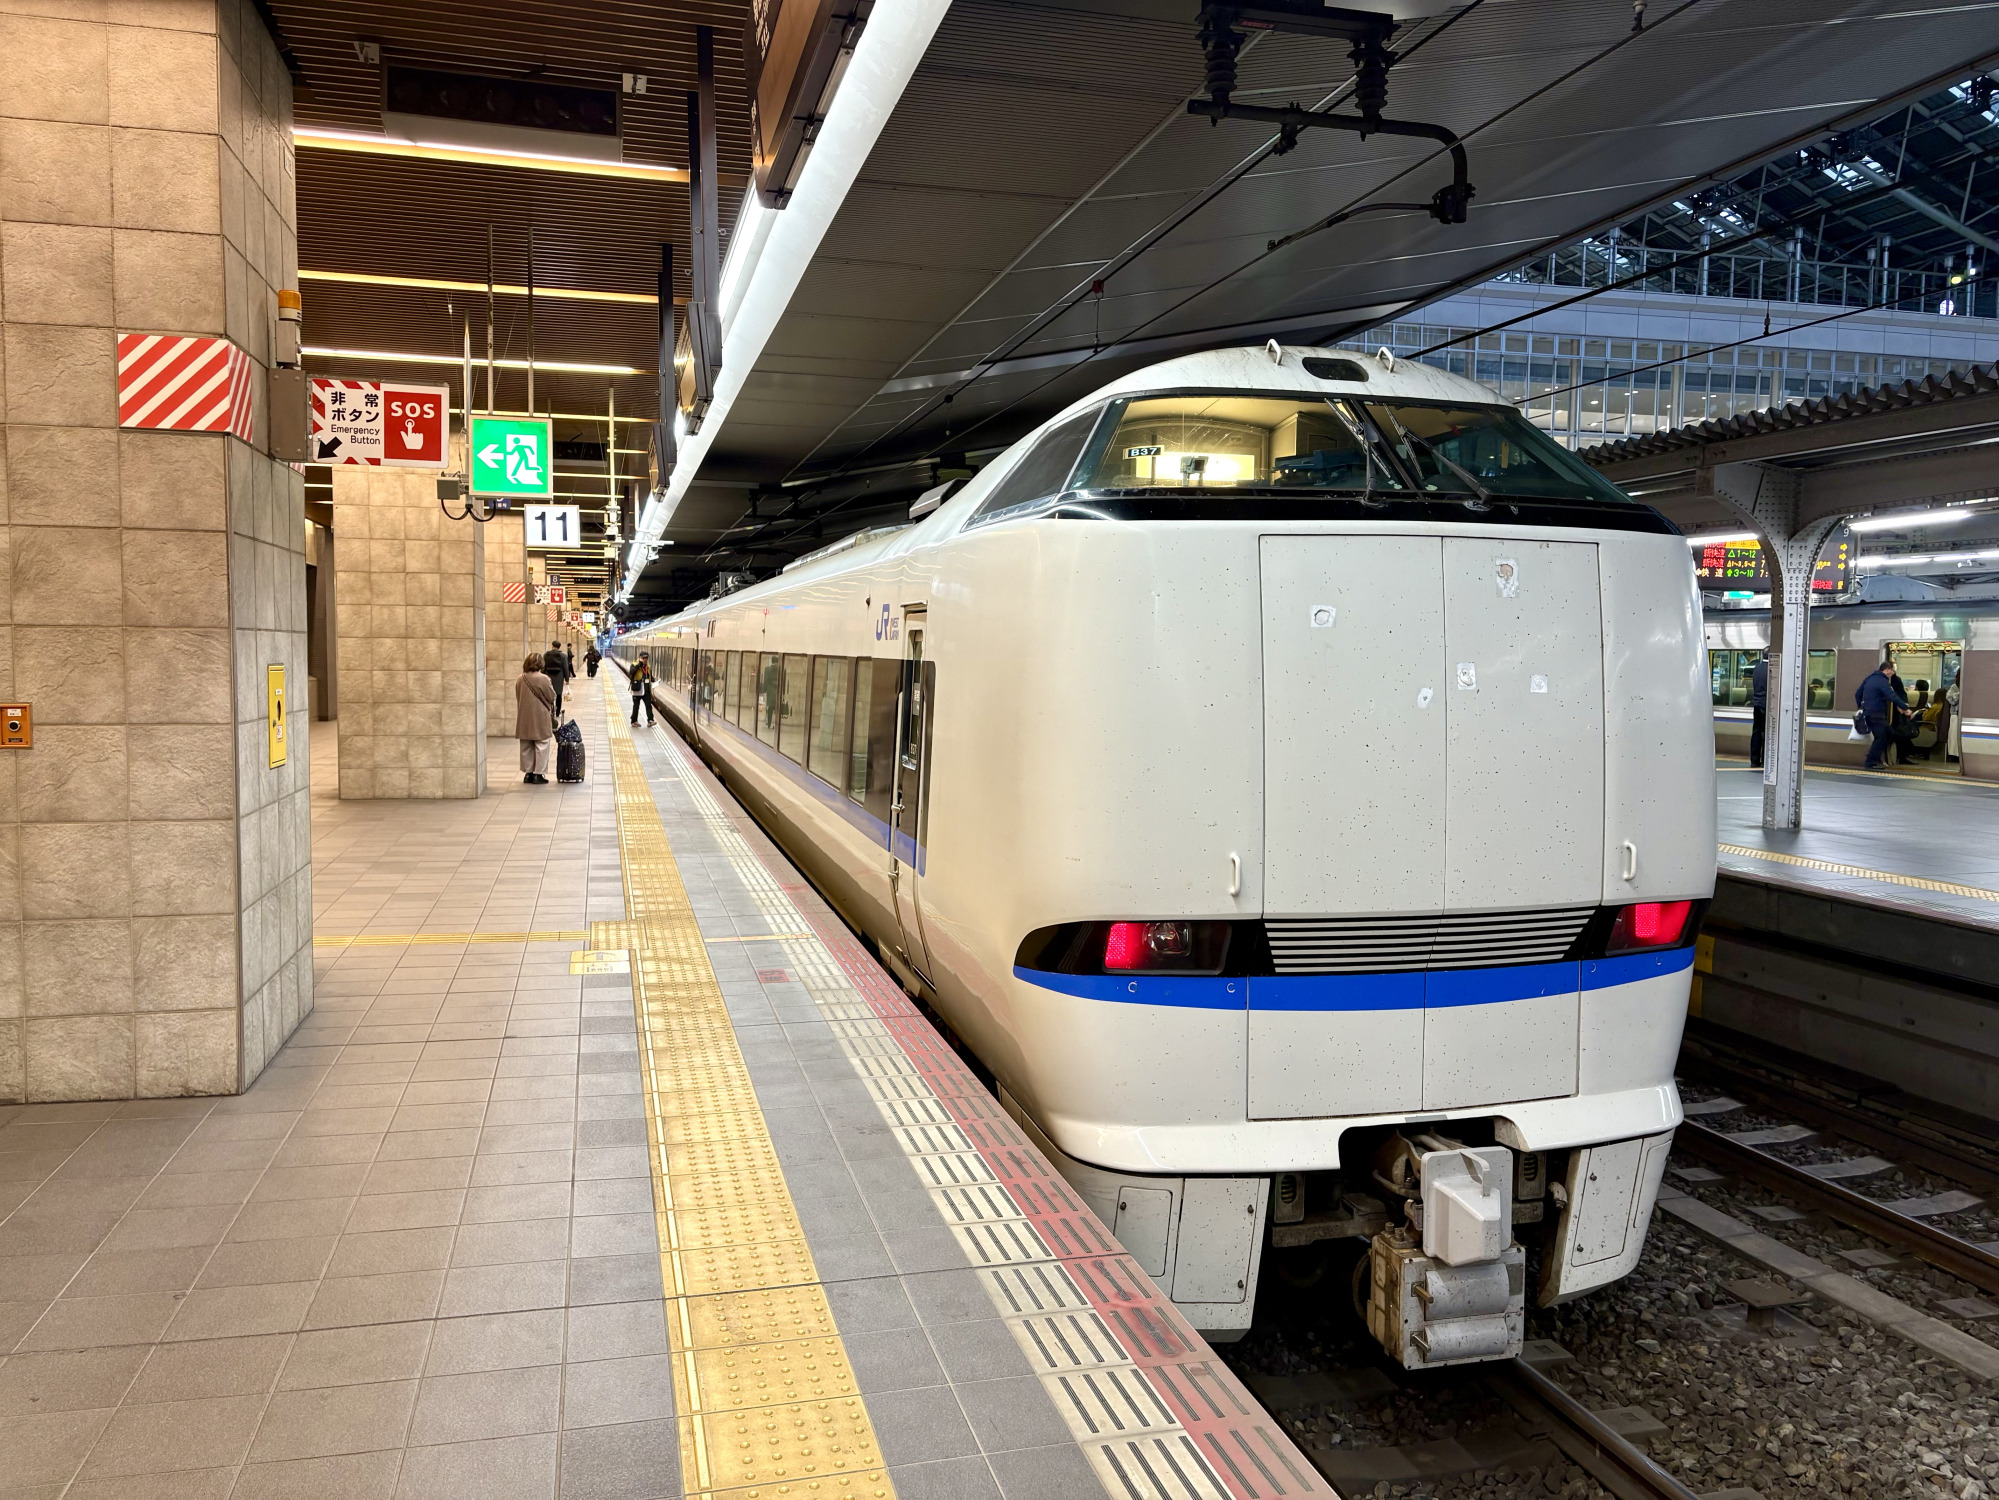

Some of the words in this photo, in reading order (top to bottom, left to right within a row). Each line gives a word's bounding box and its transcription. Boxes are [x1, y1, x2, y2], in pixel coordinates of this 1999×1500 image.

[331, 391, 379, 408] 非常
[332, 408, 380, 423] ボタン
[391, 401, 435, 419] SOS
[331, 424, 381, 435] Emergency
[350, 435, 381, 445] Button
[1131, 448, 1157, 456] B37
[534, 511, 568, 542] 11
[1843, 528, 1850, 537] 9
[875, 603, 890, 641] JR
